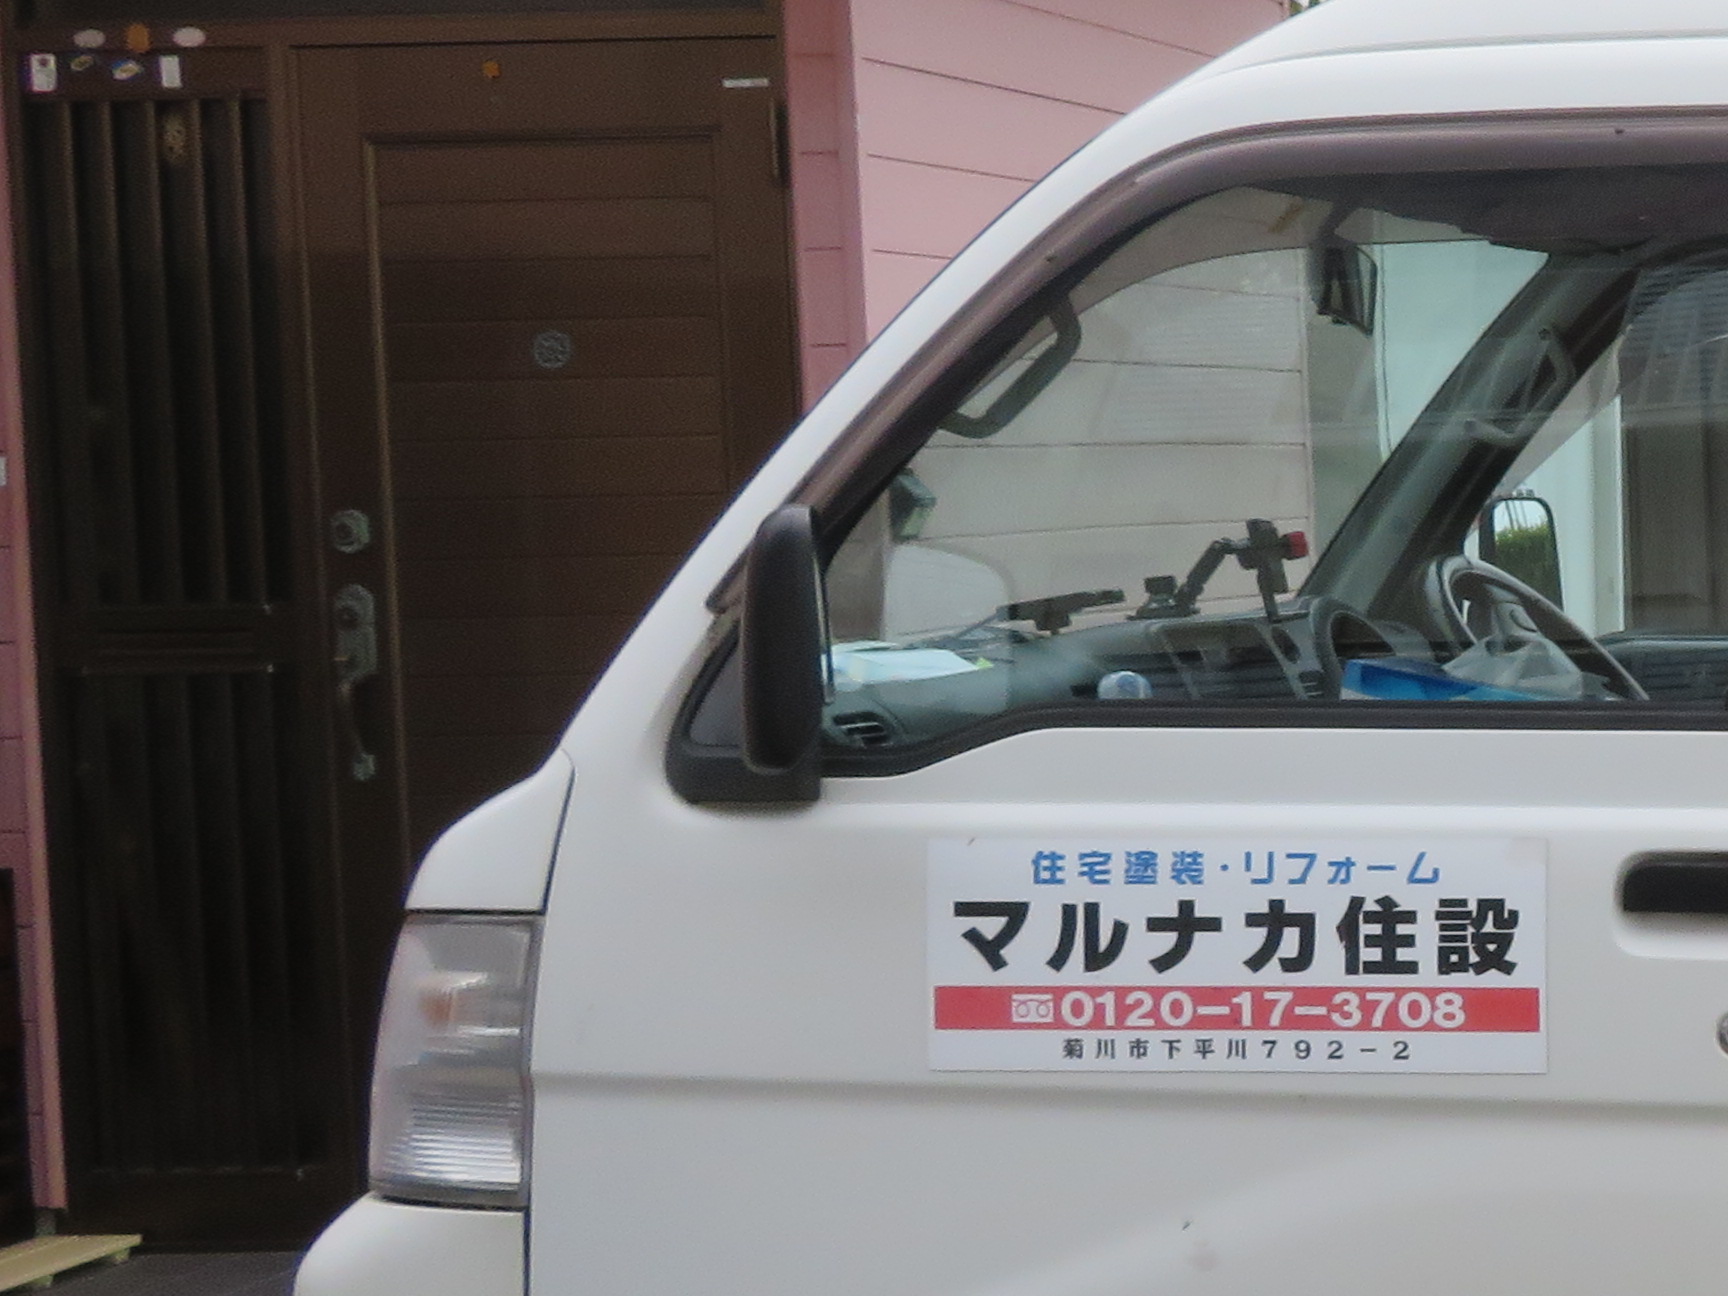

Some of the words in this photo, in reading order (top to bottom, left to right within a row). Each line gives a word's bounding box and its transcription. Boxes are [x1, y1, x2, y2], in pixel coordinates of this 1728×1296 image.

[1031, 850, 1441, 885] 住宅塗装・リフォーム
[953, 895, 1520, 976] マルナカ住設
[1061, 991, 1465, 1028] 0120-17-3708
